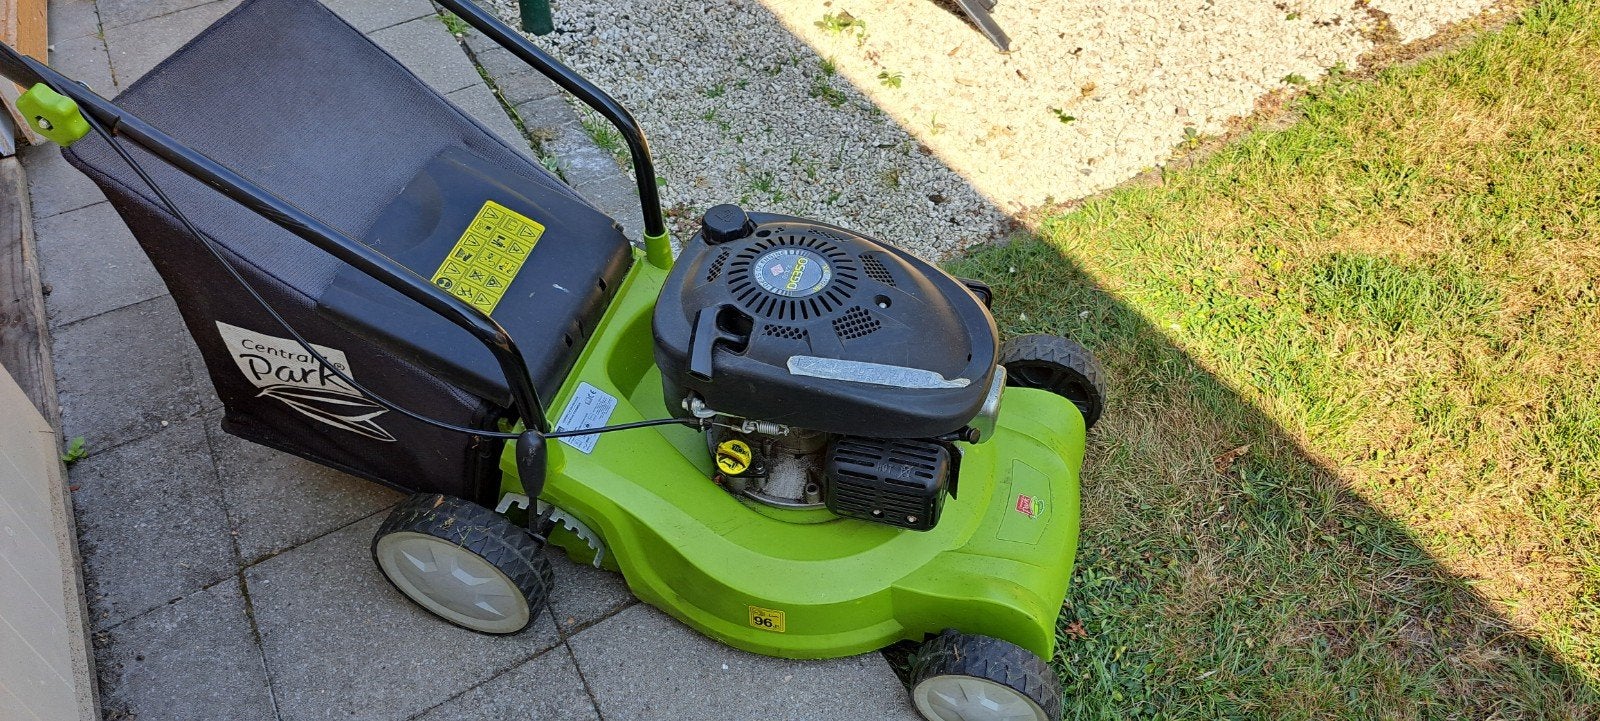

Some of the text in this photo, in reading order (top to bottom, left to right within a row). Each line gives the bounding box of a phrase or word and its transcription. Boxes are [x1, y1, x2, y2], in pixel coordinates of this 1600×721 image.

[241, 339, 315, 364] Central
[239, 352, 352, 391] Park
[754, 616, 773, 628] 96
